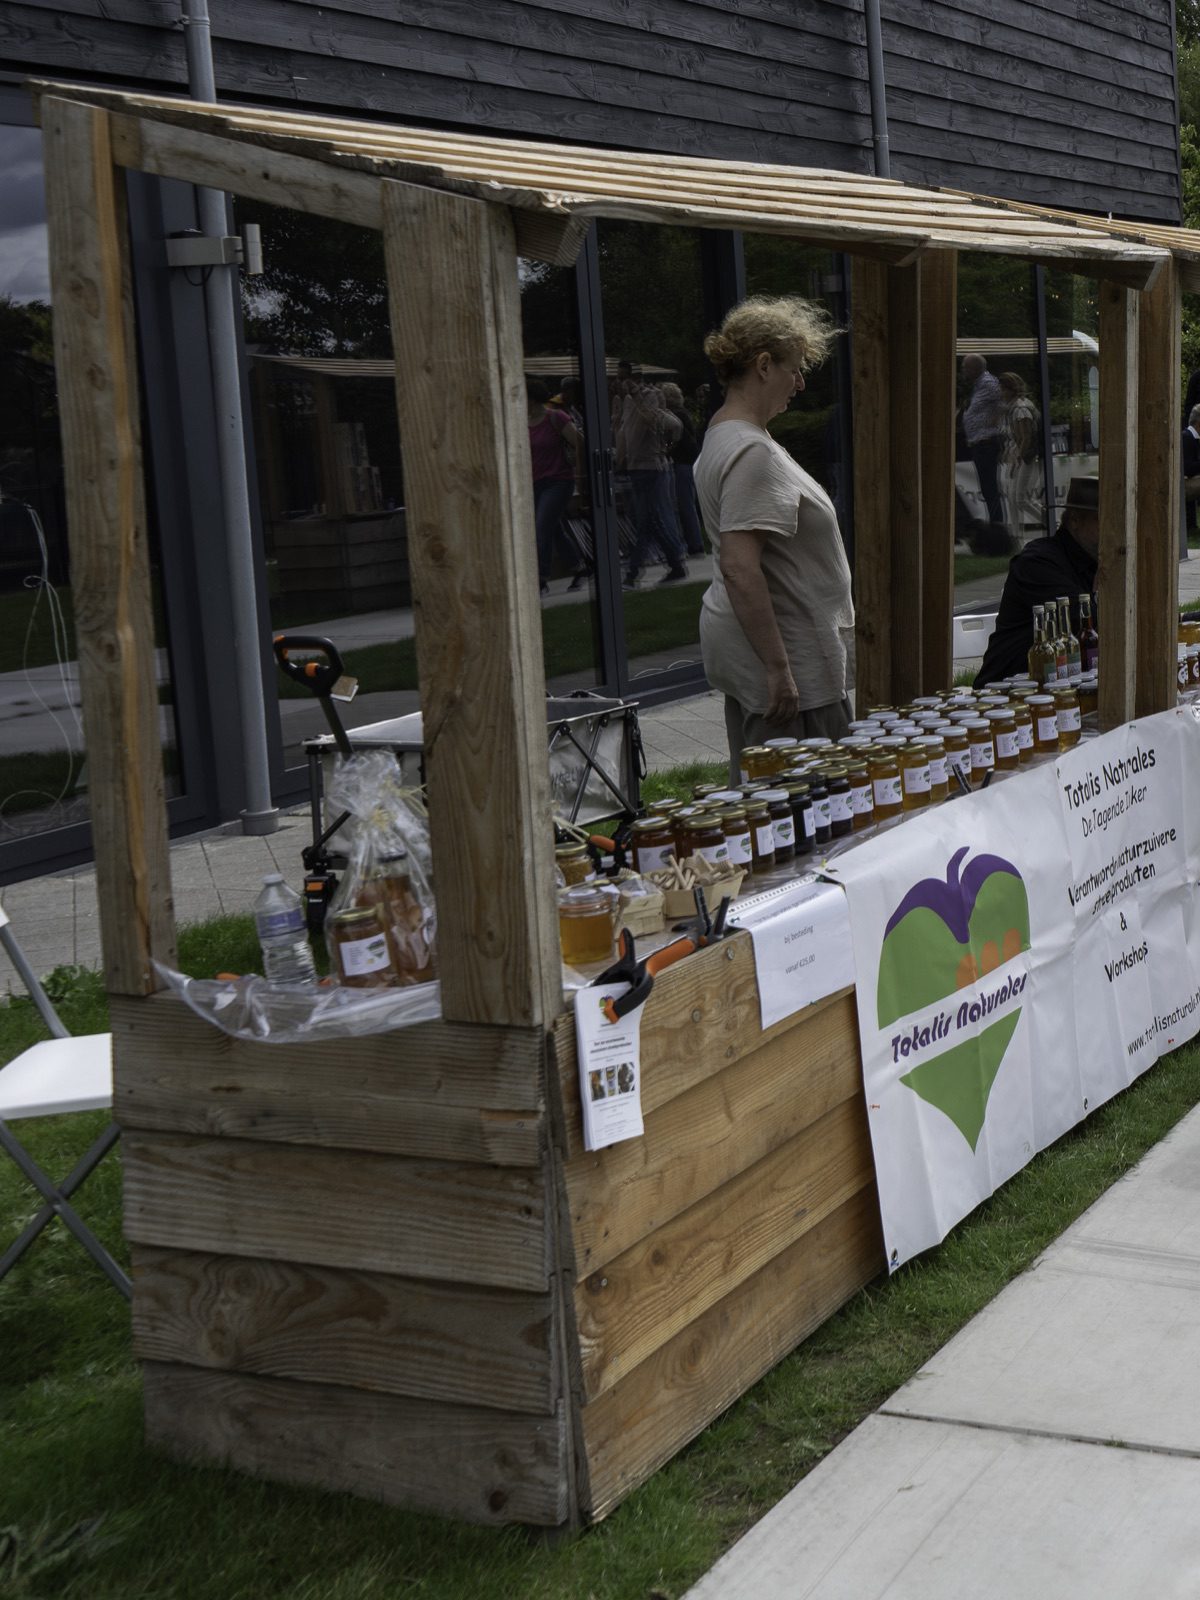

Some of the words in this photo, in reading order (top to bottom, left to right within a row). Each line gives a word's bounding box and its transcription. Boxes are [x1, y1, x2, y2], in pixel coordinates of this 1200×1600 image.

[1125, 785, 1147, 810] Iker
[1119, 912, 1128, 931] &
[891, 1012, 952, 1063] Totalis
[957, 973, 1027, 1029] Naturales
